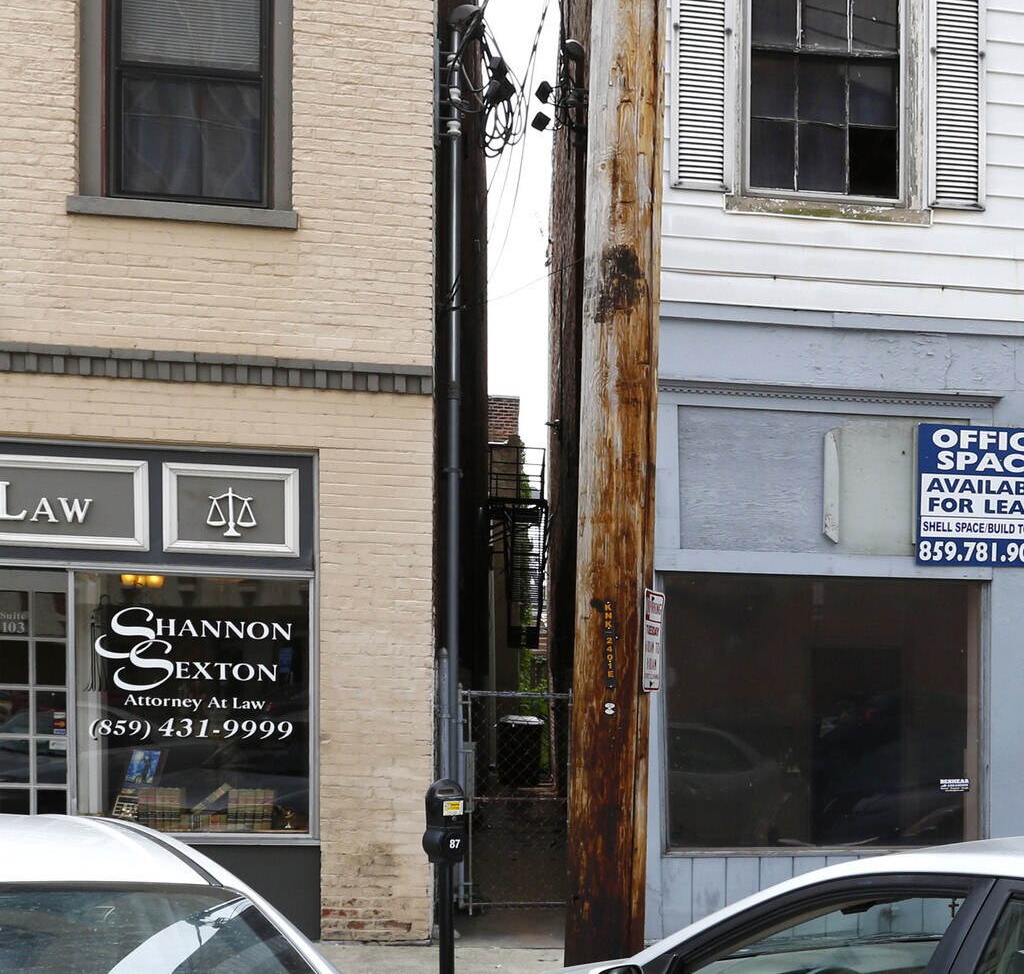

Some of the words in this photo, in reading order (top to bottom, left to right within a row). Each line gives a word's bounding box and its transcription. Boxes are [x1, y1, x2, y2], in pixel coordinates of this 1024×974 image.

[0, 481, 93, 523] LAW
[928, 497, 974, 514] FOR
[922, 521, 953, 533] SHELL
[955, 522, 1015, 535] SPACE/BUILD
[0, 611, 26, 620] Suite
[2, 621, 25, 633] 103
[95, 607, 293, 659] SHANNON
[113, 639, 278, 691] SEXTON
[124, 694, 203, 712] Attorney
[207, 697, 228, 709] At
[232, 697, 266, 710] Law
[88, 718, 151, 740] (859)
[158, 717, 293, 740] 431-9999
[449, 839, 461, 849] 87
